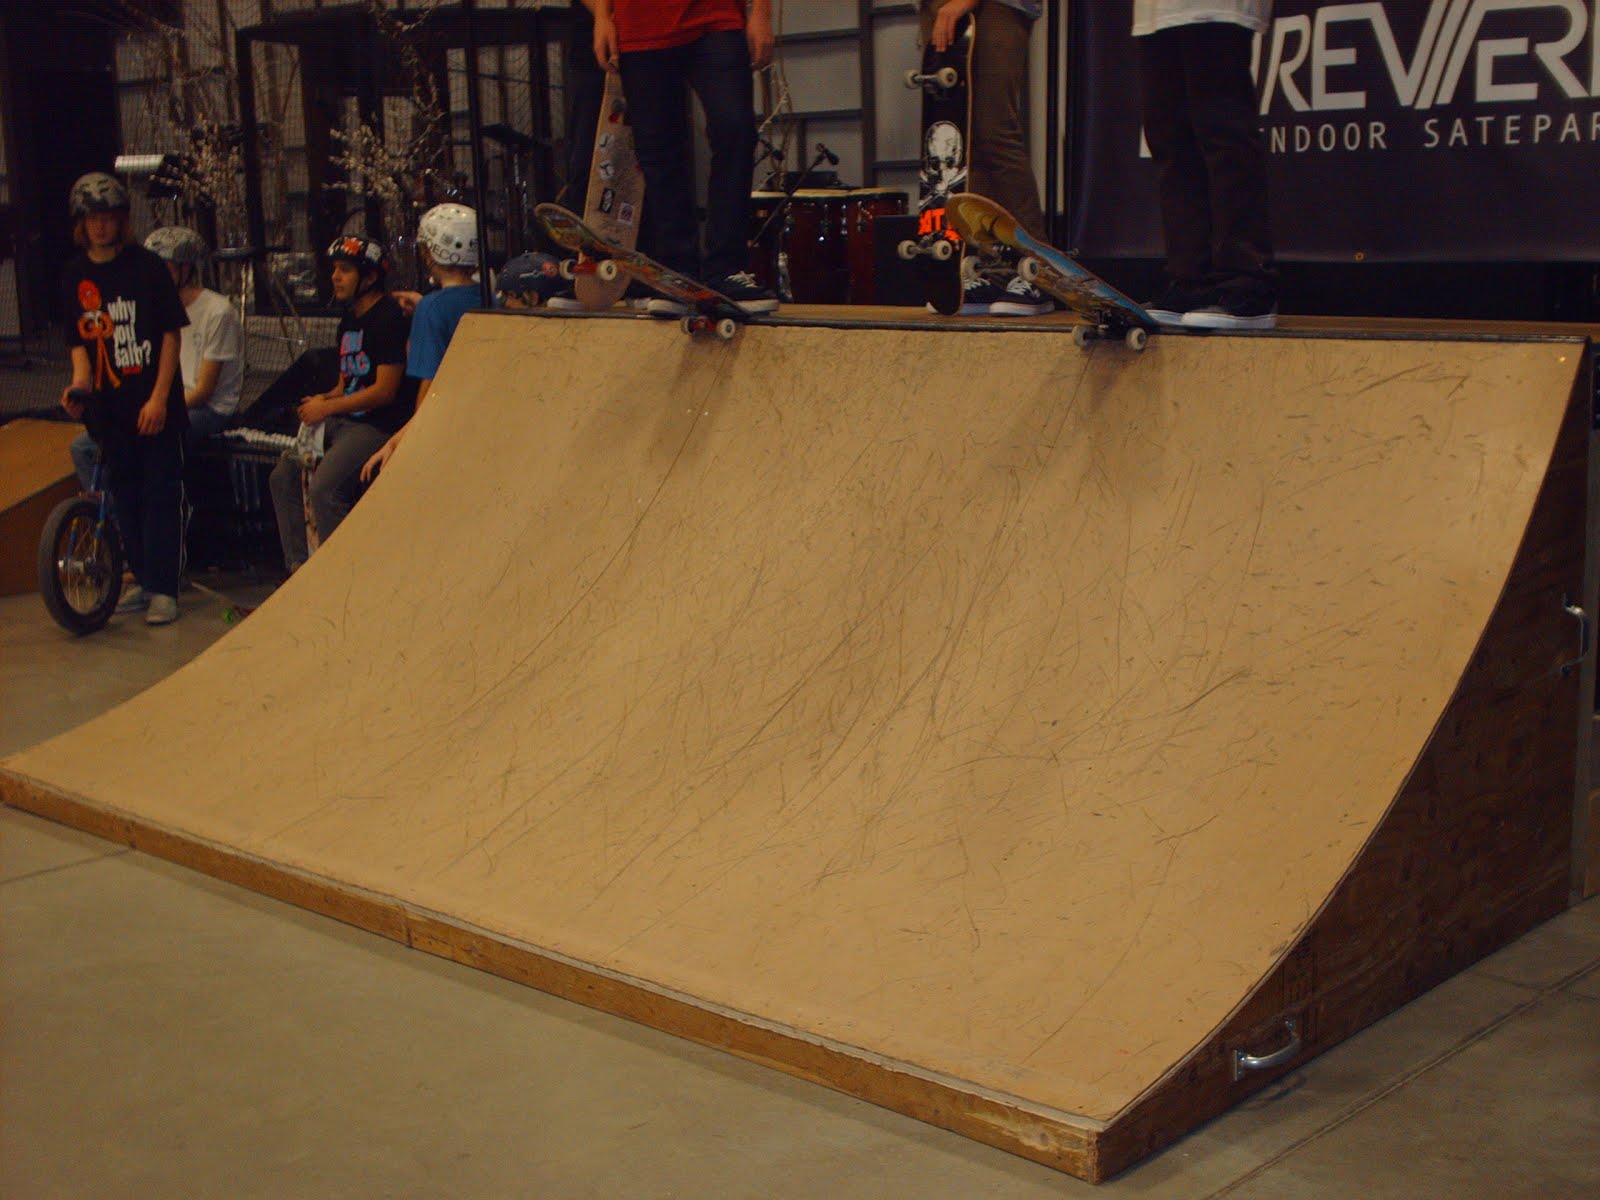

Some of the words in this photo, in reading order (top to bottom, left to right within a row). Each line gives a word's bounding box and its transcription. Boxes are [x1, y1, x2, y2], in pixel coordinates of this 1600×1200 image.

[1259, 121, 1387, 153] NDOOR
[107, 296, 136, 325] why
[113, 324, 136, 347] you
